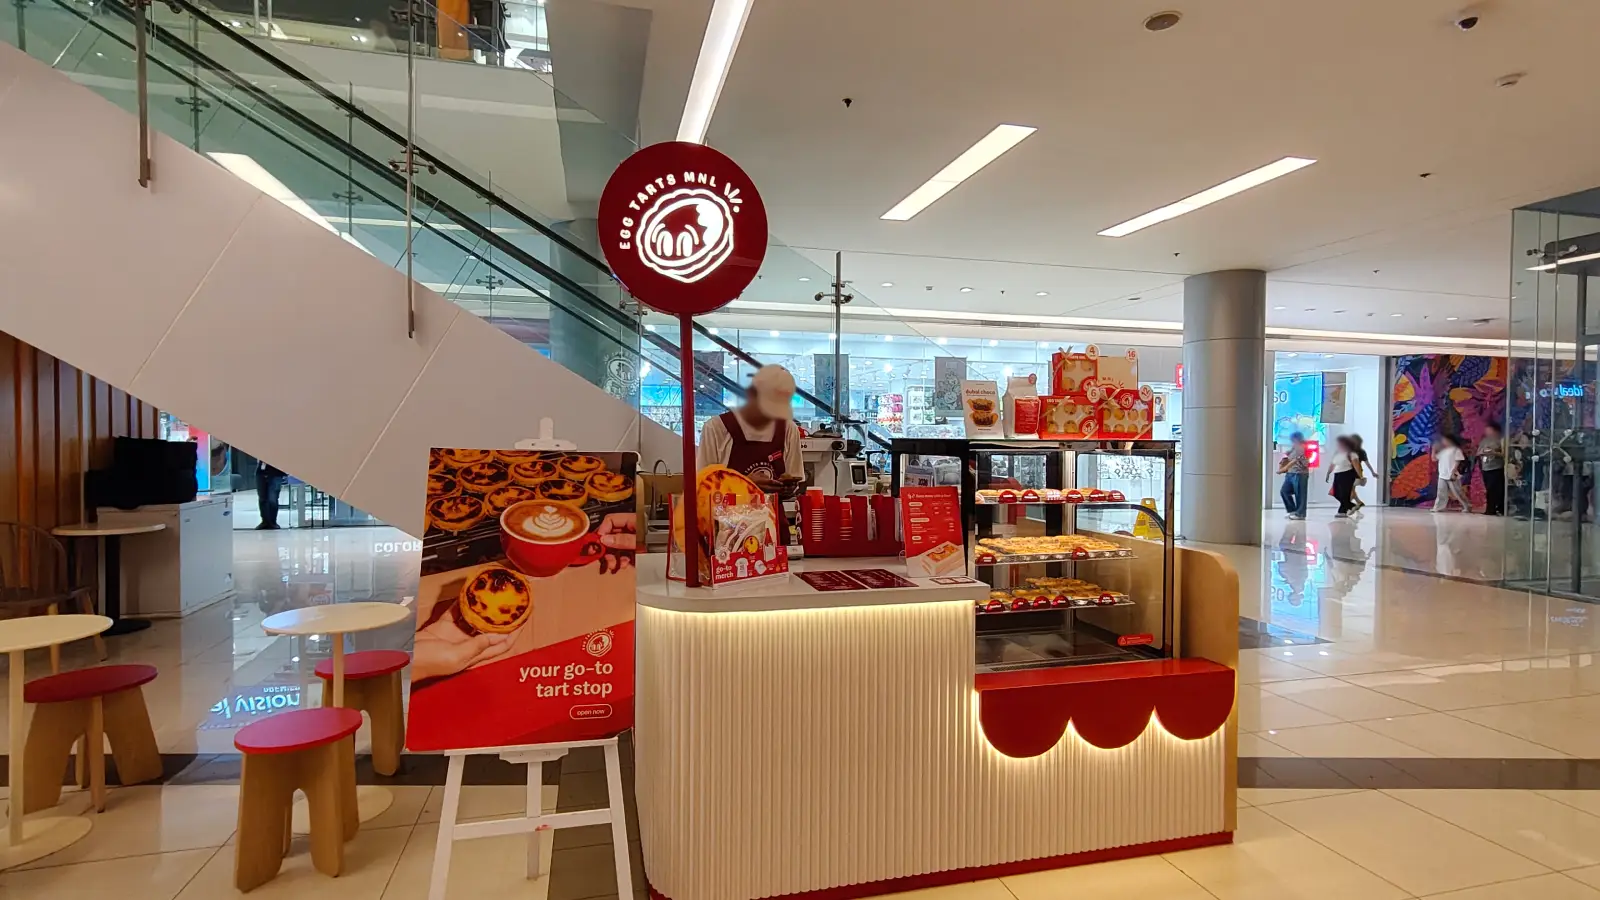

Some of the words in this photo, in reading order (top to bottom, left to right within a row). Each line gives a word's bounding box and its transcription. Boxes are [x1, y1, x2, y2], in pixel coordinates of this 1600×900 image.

[619, 217, 634, 250] EGG
[629, 173, 677, 211] TARTS
[684, 171, 717, 188] MNL
[1141, 387, 1151, 398] 12
[716, 564, 733, 575] go-to
[715, 571, 734, 581] merch
[519, 664, 560, 683] your
[564, 661, 613, 680] go-to
[536, 683, 569, 698] tart
[572, 682, 613, 699] stop
[576, 708, 592, 717] open
